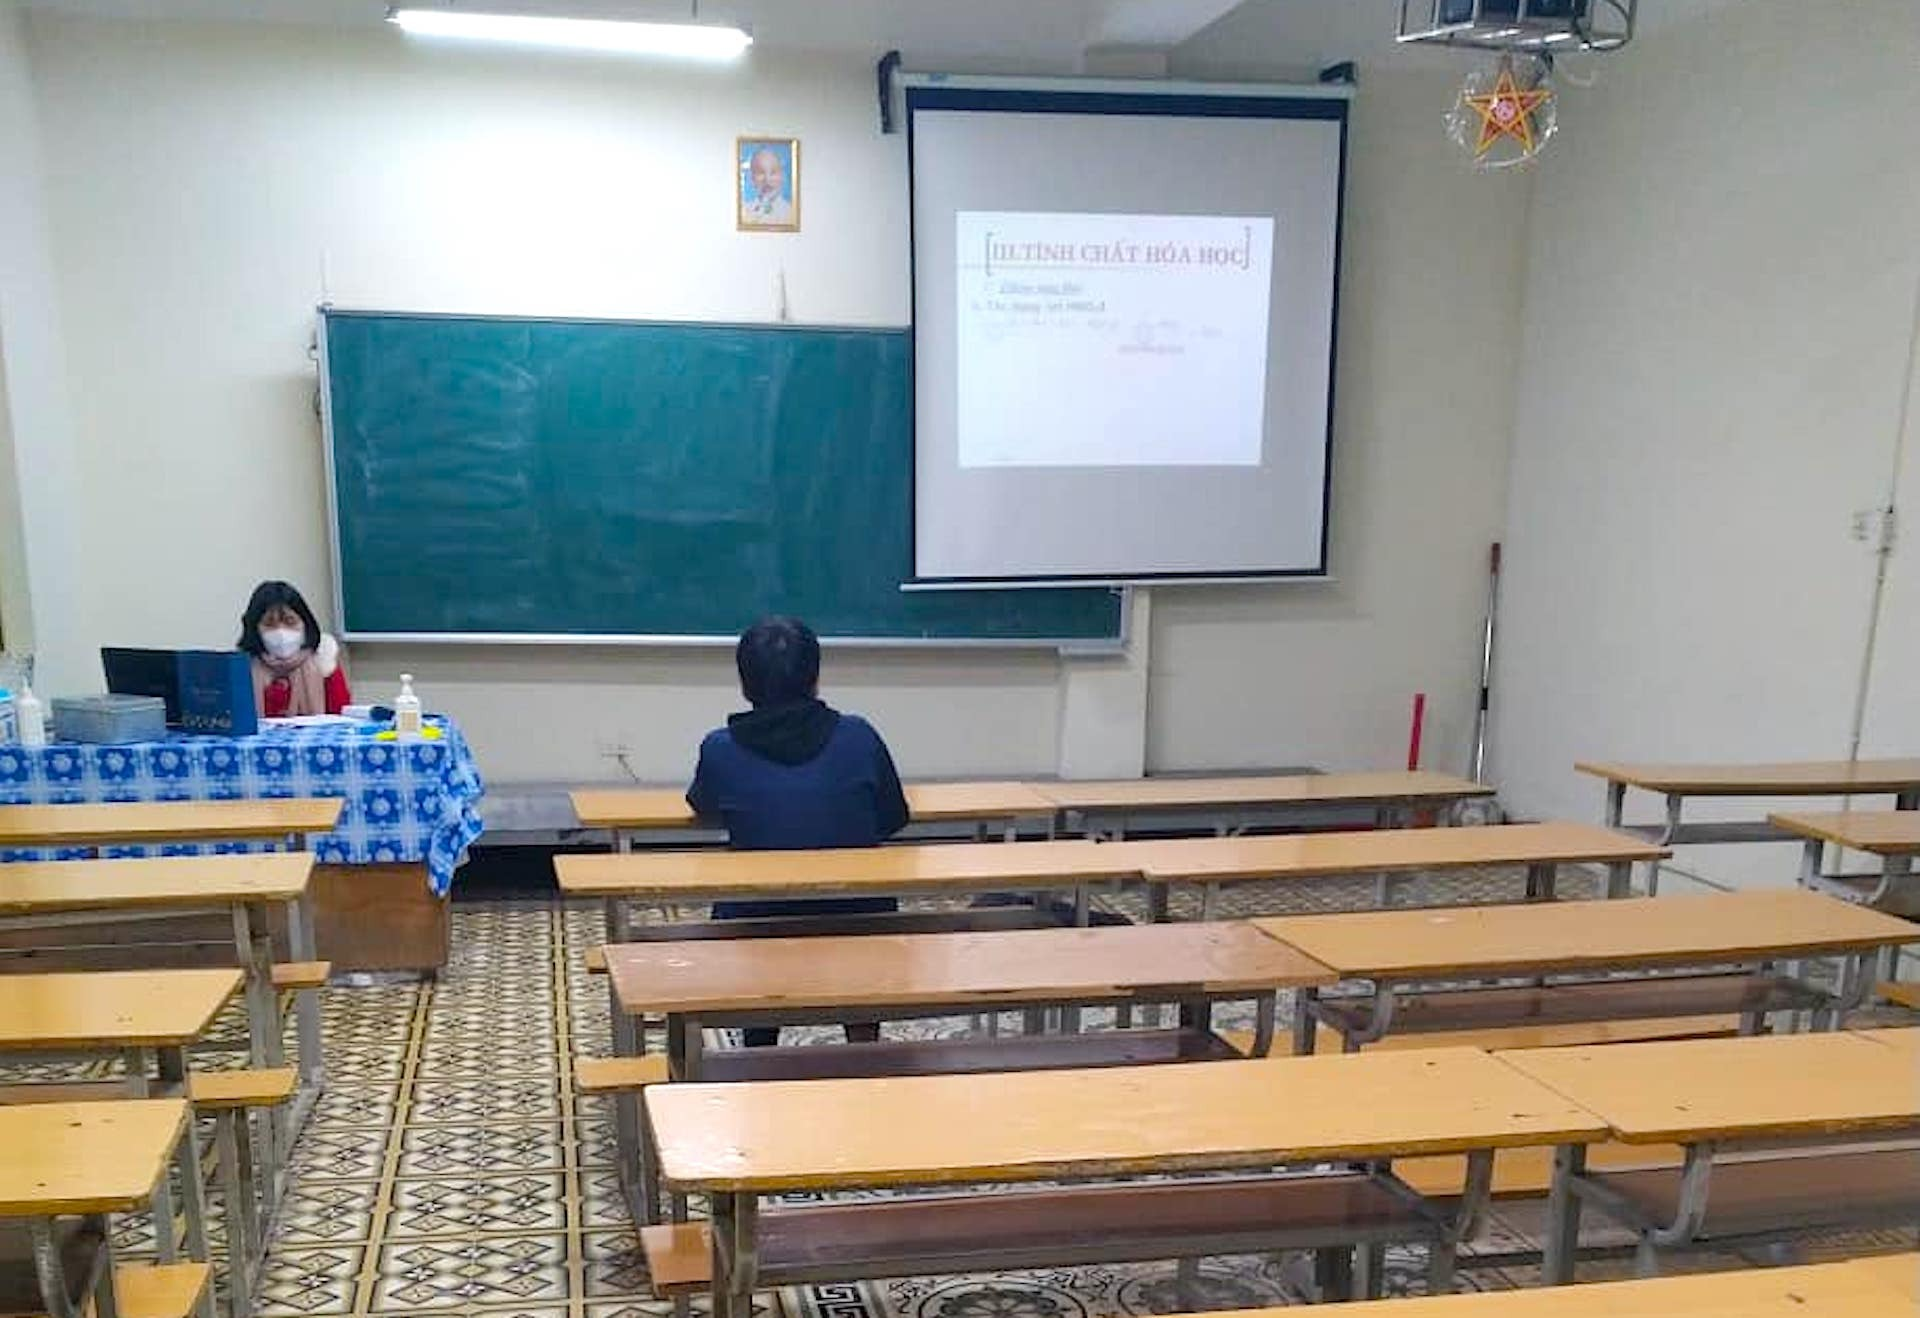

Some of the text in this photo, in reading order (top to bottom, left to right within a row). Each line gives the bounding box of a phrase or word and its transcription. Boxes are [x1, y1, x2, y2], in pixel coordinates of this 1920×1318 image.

[1081, 236, 1139, 264] CHẤT
[1146, 240, 1192, 265] HÓA
[1198, 244, 1244, 268] HỌC
